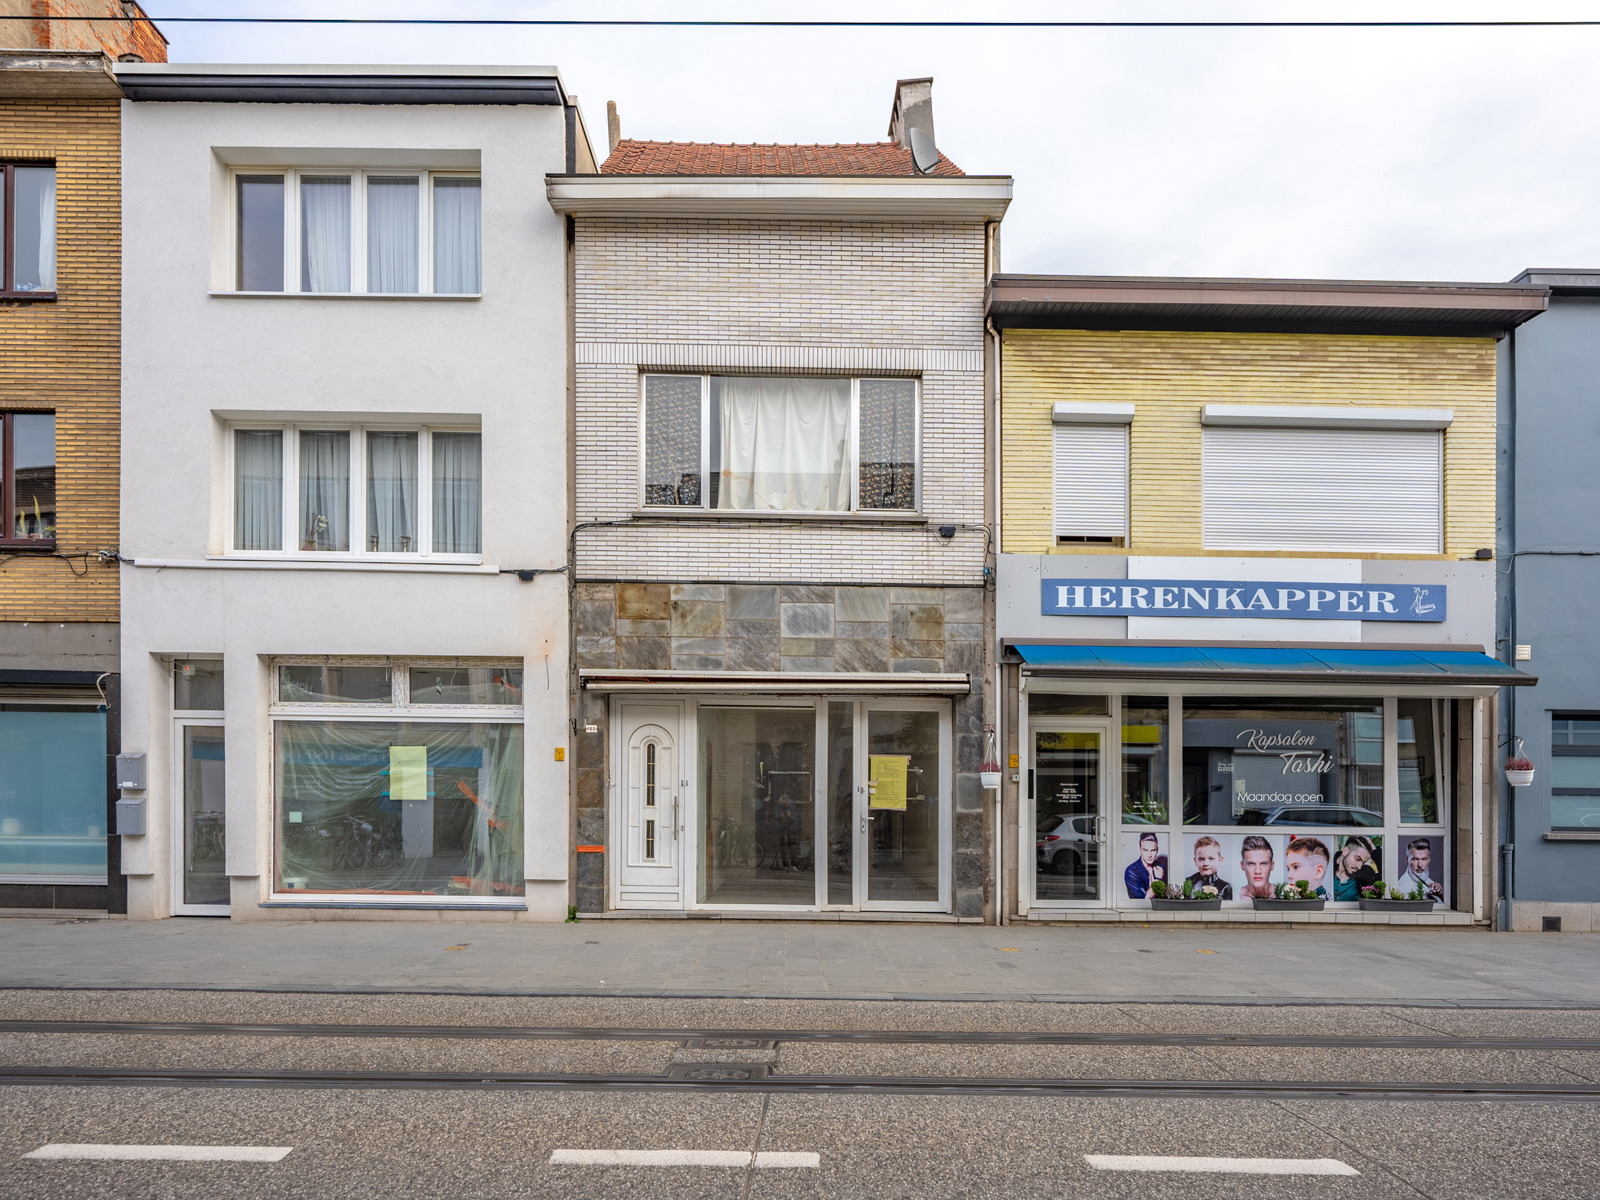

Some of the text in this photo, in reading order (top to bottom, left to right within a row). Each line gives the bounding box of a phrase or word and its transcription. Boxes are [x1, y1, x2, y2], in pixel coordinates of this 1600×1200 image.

[1055, 584, 1399, 614] HERENKAPPER
[1236, 729, 1317, 753] Kapsalon
[1279, 751, 1335, 775] Tashi
[1237, 791, 1324, 804] Maandag open
